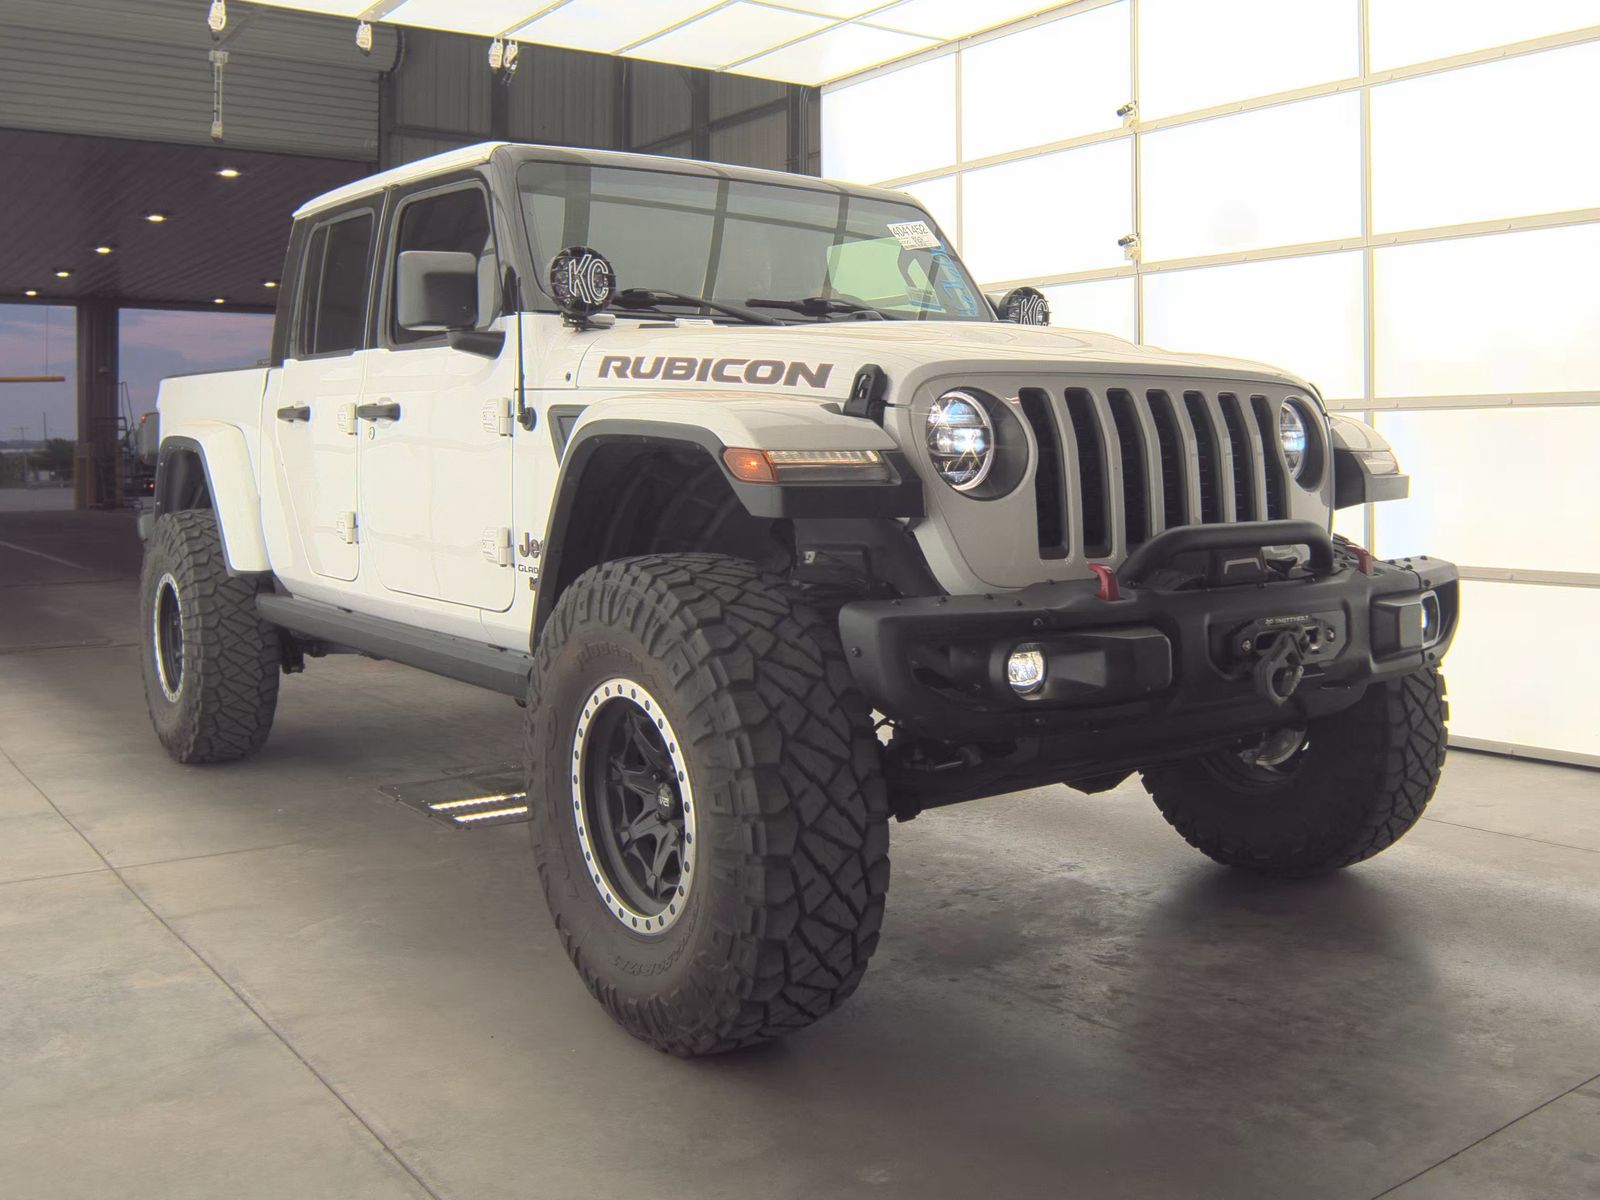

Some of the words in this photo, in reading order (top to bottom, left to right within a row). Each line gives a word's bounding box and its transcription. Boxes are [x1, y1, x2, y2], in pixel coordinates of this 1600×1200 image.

[568, 253, 609, 304] KC
[1020, 294, 1048, 326] KC
[598, 355, 834, 388] RUBICON
